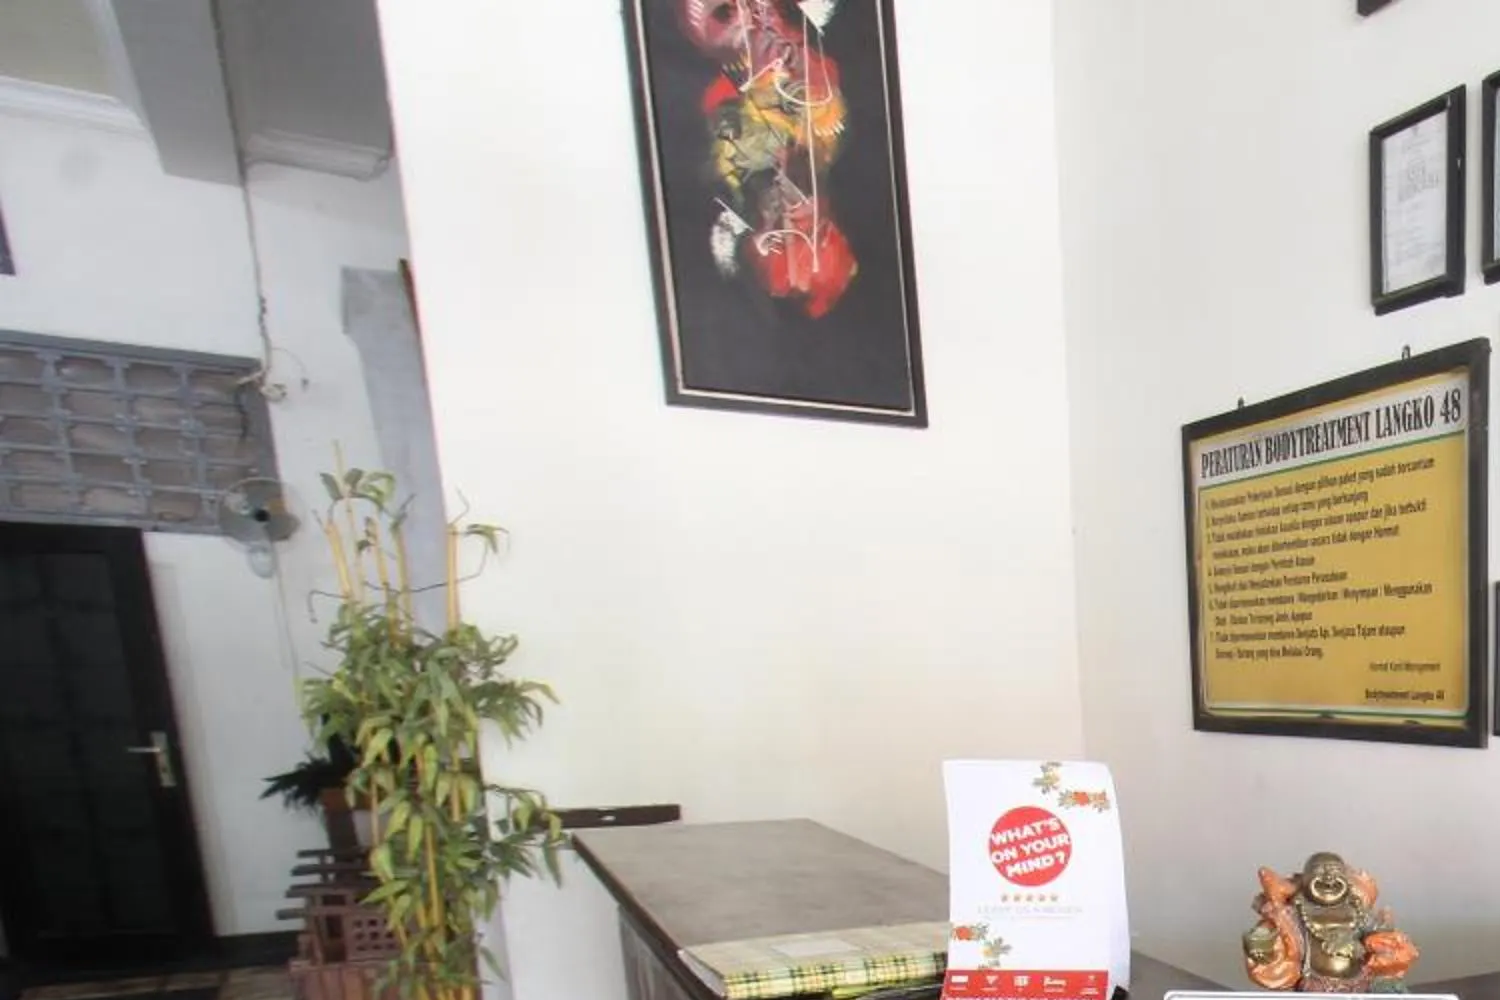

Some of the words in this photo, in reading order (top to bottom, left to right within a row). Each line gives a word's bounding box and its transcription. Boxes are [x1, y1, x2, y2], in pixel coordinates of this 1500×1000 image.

[1200, 437, 1262, 478] PERATURAN
[1265, 410, 1371, 465] BODYTREATMENT
[1375, 395, 1435, 438] LANGKO
[1439, 387, 1462, 425] 48
[991, 818, 1060, 845] WHAT'S
[991, 847, 1018, 864] ON
[1020, 833, 1070, 856] YOUR
[1006, 854, 1054, 877] MIND
